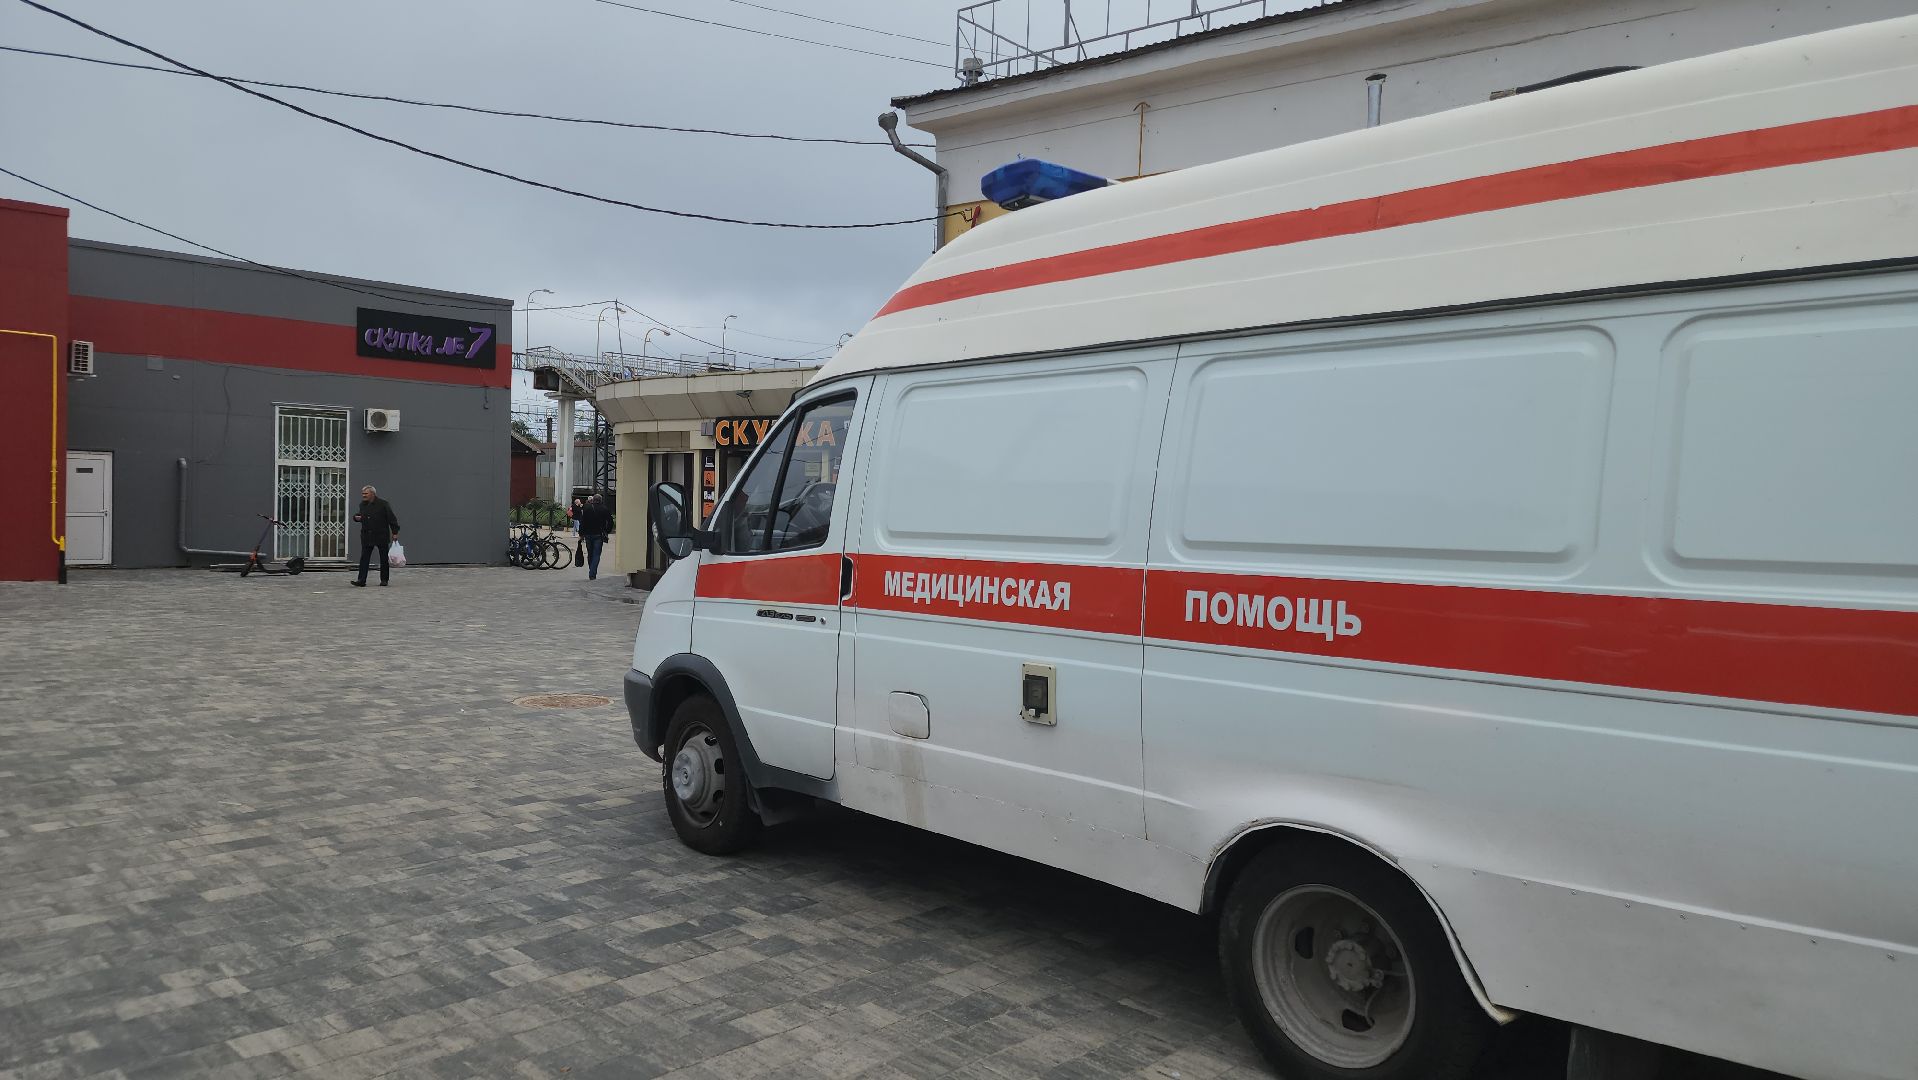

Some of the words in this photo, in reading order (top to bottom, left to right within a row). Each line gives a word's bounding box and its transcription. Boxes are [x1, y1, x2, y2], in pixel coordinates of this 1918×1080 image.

[364, 327, 433, 356] СКУПКА
[715, 419, 836, 448] СКУКА
[884, 570, 1071, 611] МЕДИЦИНСКАЯ
[1185, 589, 1362, 642] ПОМОЩЬ
